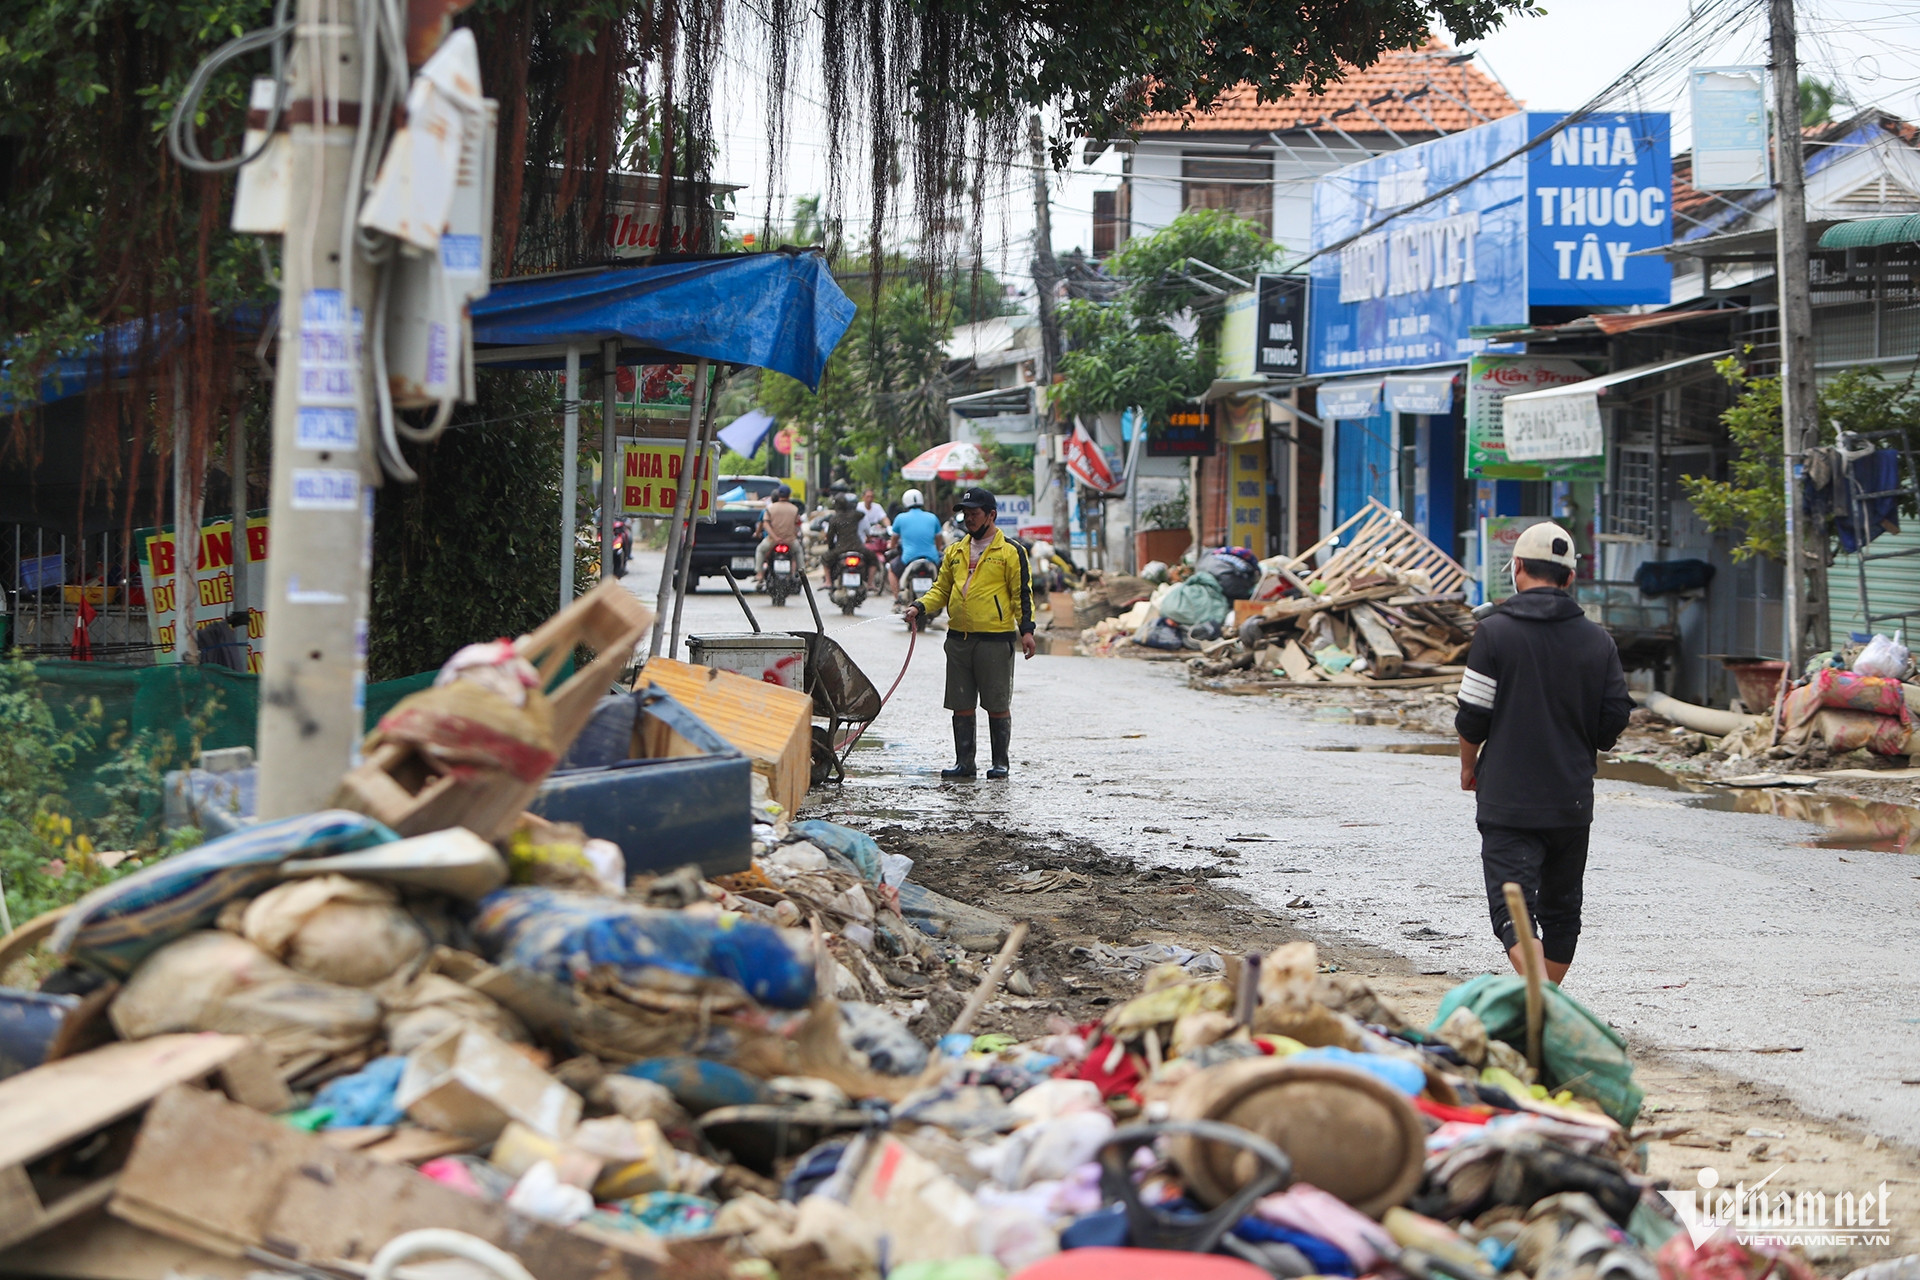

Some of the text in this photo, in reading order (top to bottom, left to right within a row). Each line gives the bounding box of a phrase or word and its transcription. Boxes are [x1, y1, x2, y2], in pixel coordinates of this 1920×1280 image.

[1551, 116, 1637, 166] NHÀ
[1536, 170, 1665, 227] THUỐC
[1554, 232, 1631, 281] TÂY
[1269, 320, 1293, 341] NHÀ
[1262, 343, 1298, 366] THUỐC
[626, 452, 663, 478] NHA
[625, 483, 652, 507] BÍ
[198, 571, 234, 606] RIÊ
